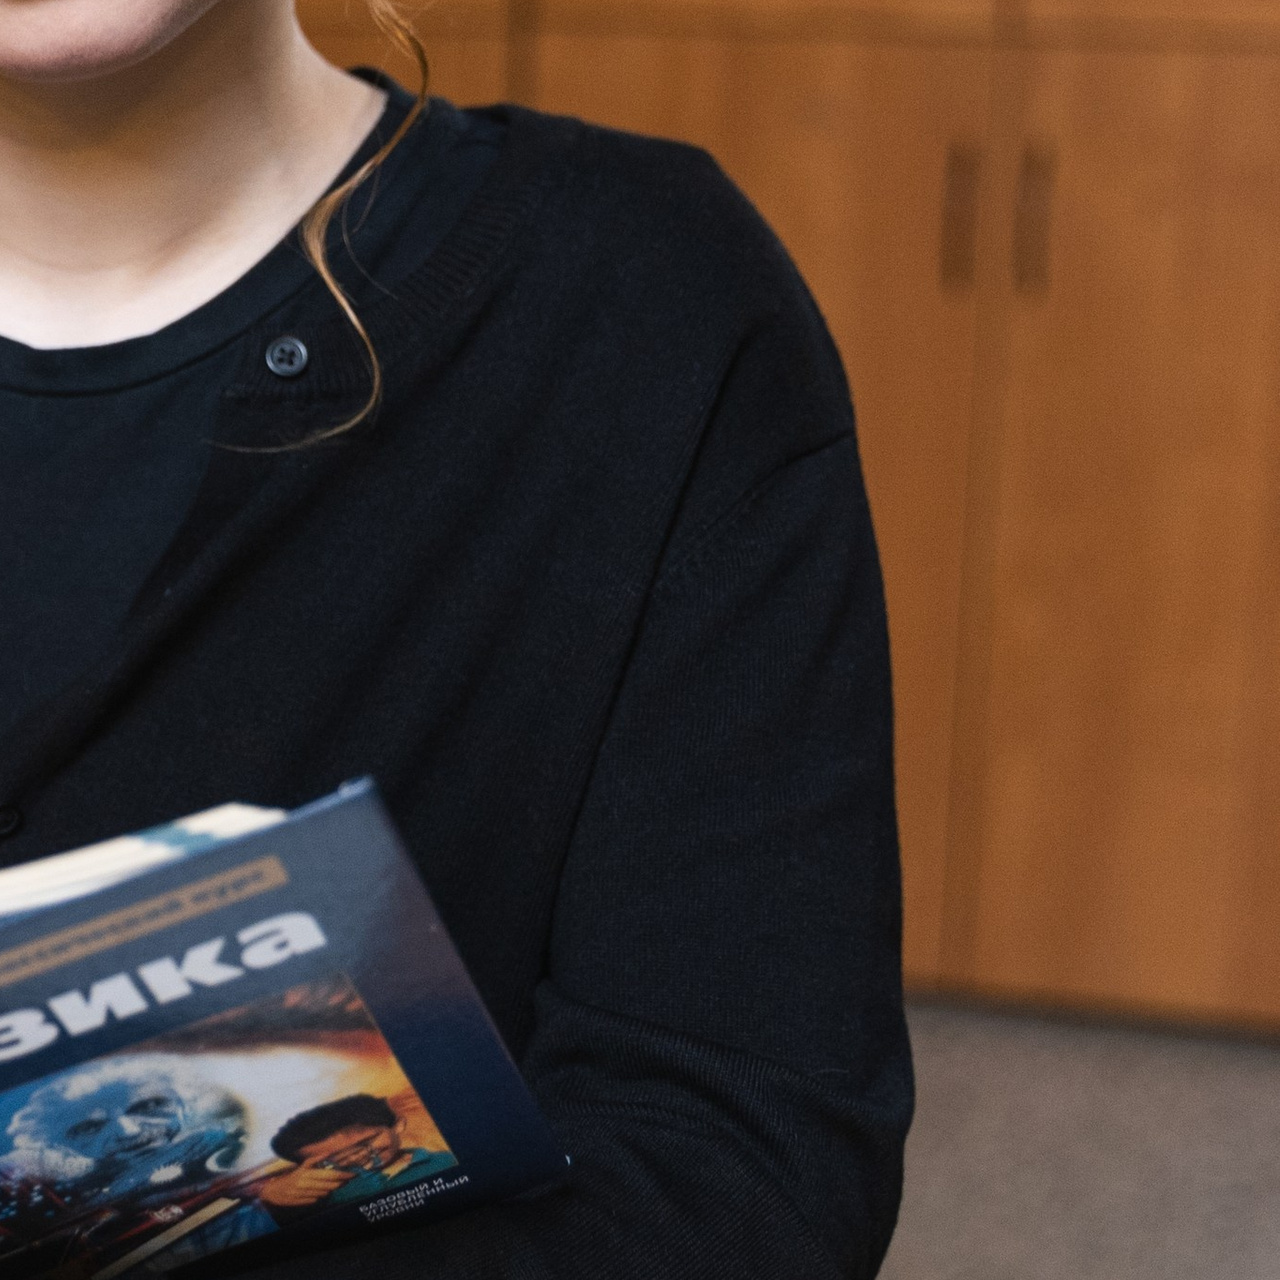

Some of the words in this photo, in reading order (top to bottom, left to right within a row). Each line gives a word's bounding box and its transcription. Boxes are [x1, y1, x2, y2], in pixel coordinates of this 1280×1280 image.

[359, 1181, 429, 1213] БАЗОВЫЙ
[433, 1177, 443, 1186] И
[367, 1198, 425, 1222] УРОВНИ
